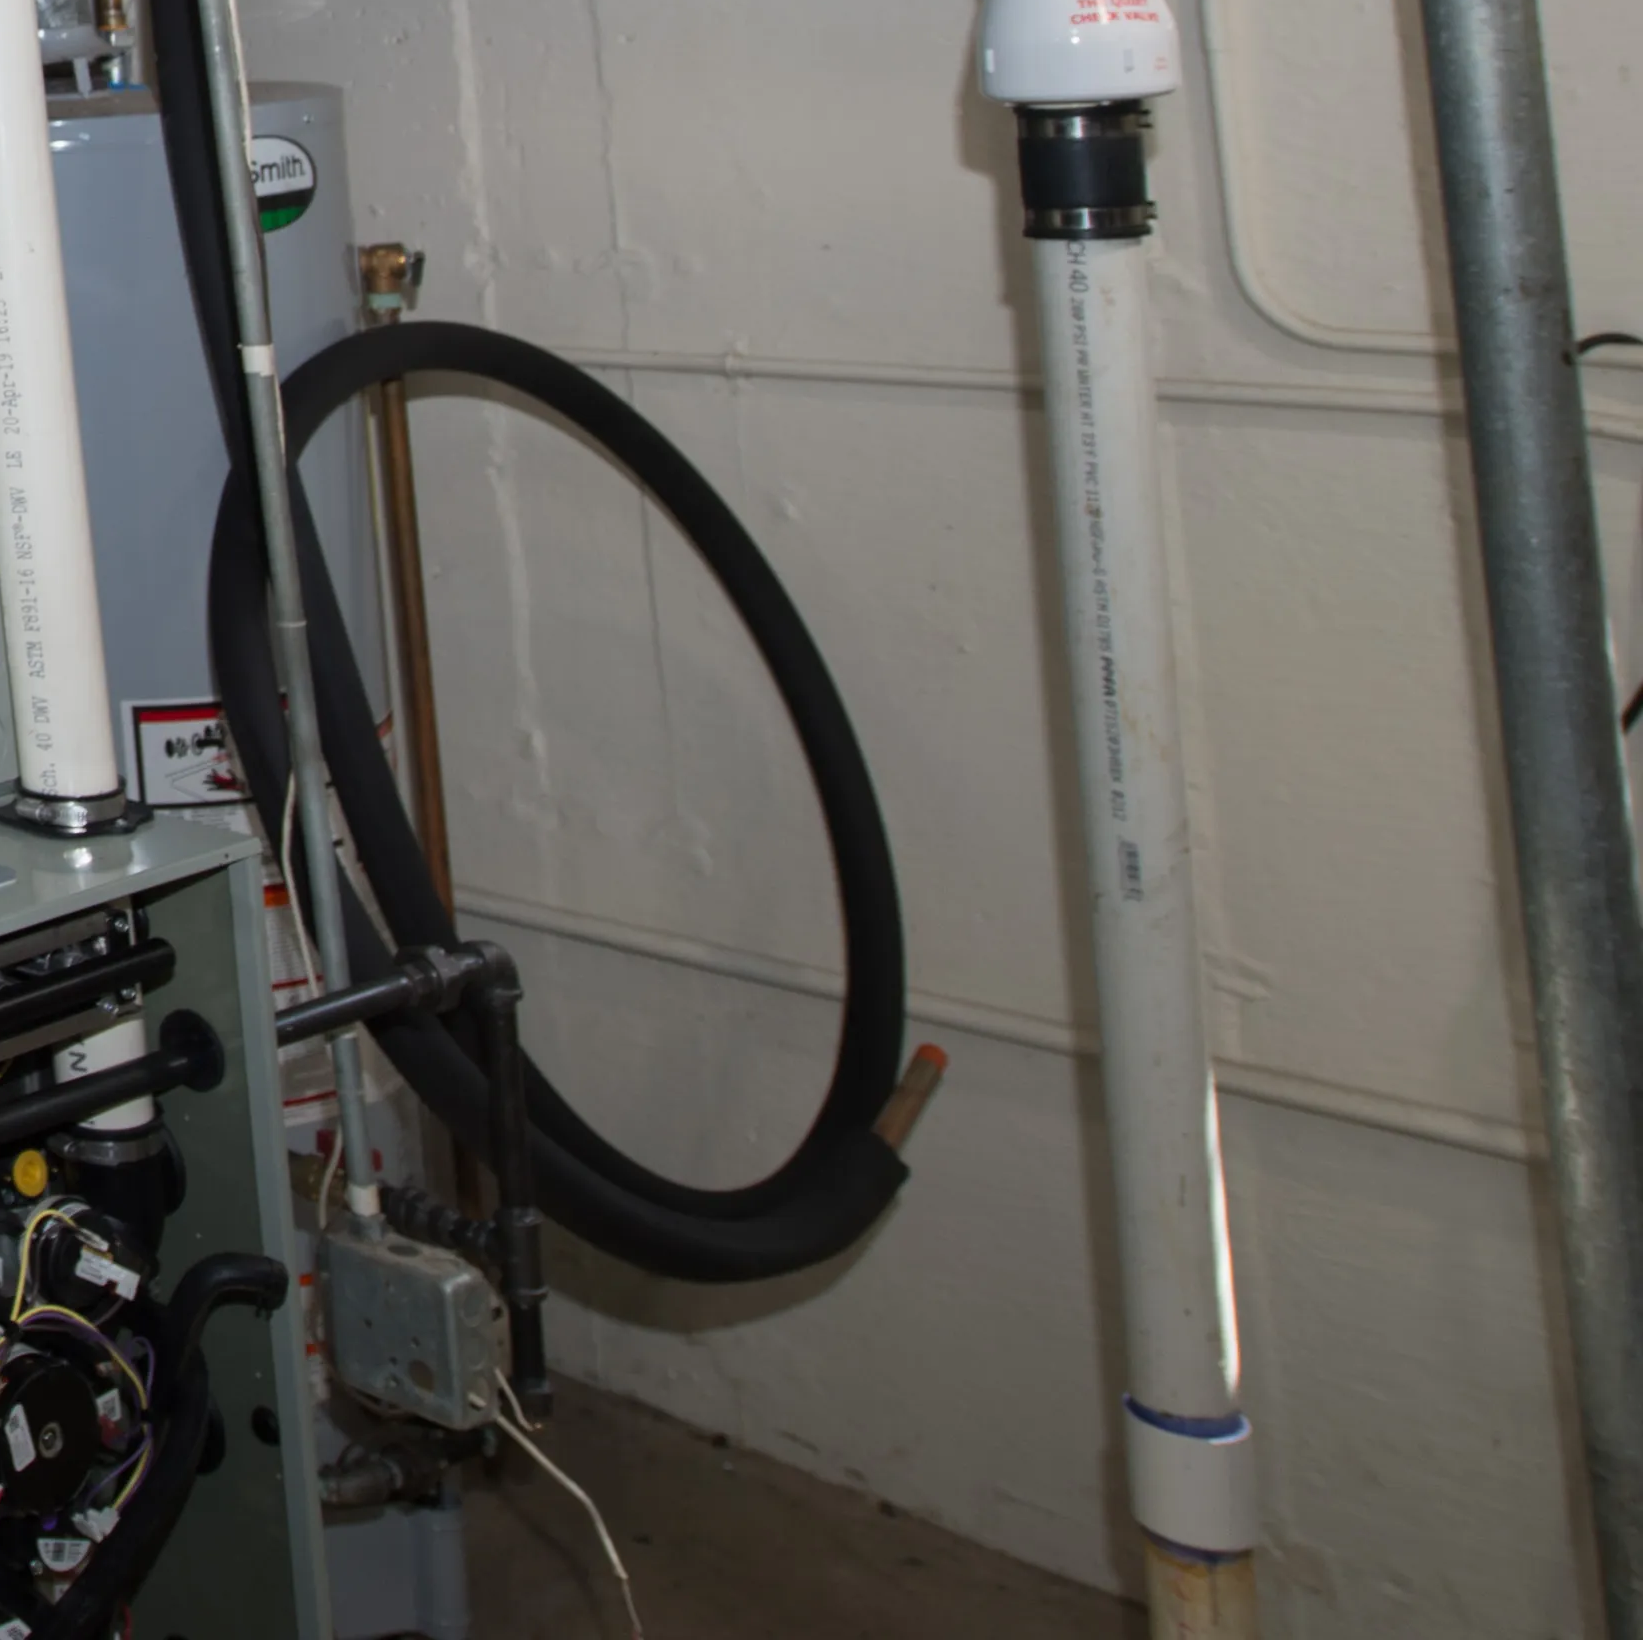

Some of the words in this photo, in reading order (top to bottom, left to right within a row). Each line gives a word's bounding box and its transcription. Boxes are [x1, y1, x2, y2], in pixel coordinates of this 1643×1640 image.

[1070, 11, 1119, 25] CHEK
[1068, 269, 1090, 293] 40
[25, 640, 46, 678] ASTM
[34, 733, 53, 751] 40
